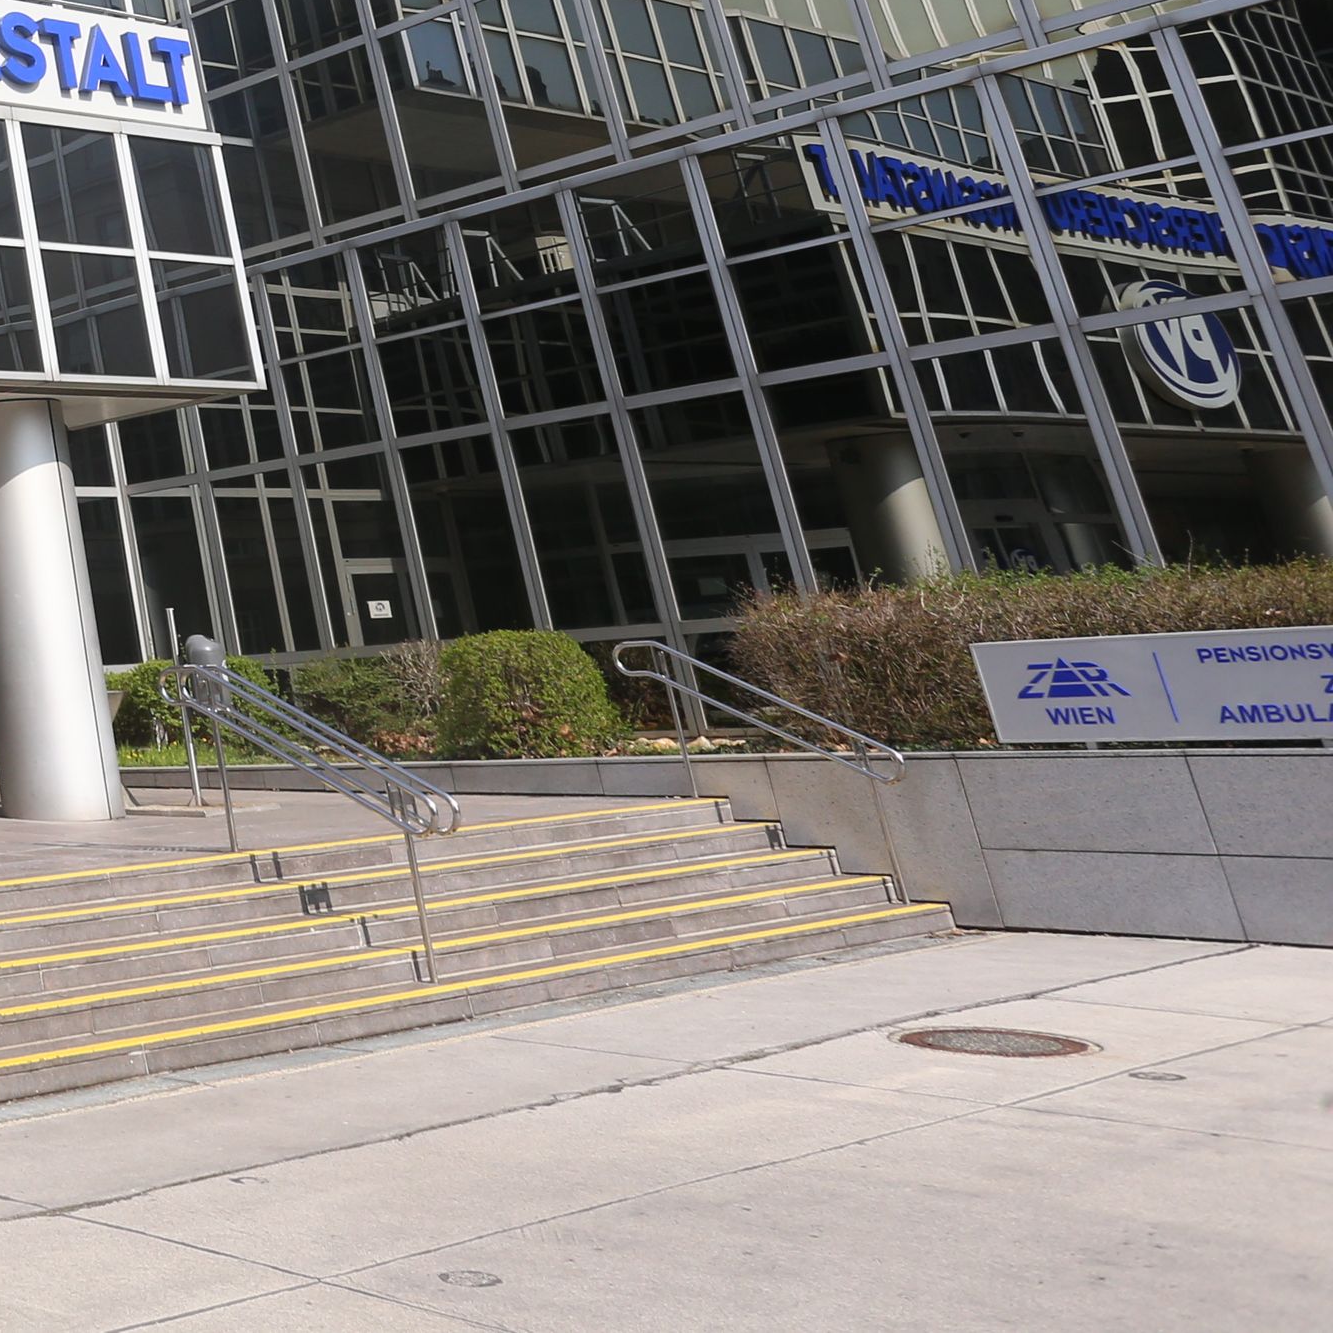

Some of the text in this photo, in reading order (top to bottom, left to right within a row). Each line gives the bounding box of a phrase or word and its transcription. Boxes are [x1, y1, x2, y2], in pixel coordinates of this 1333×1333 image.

[1017, 657, 1132, 699] ZAR
[1045, 706, 1116, 726] WIEN
[1220, 703, 1333, 724] AMBUL
